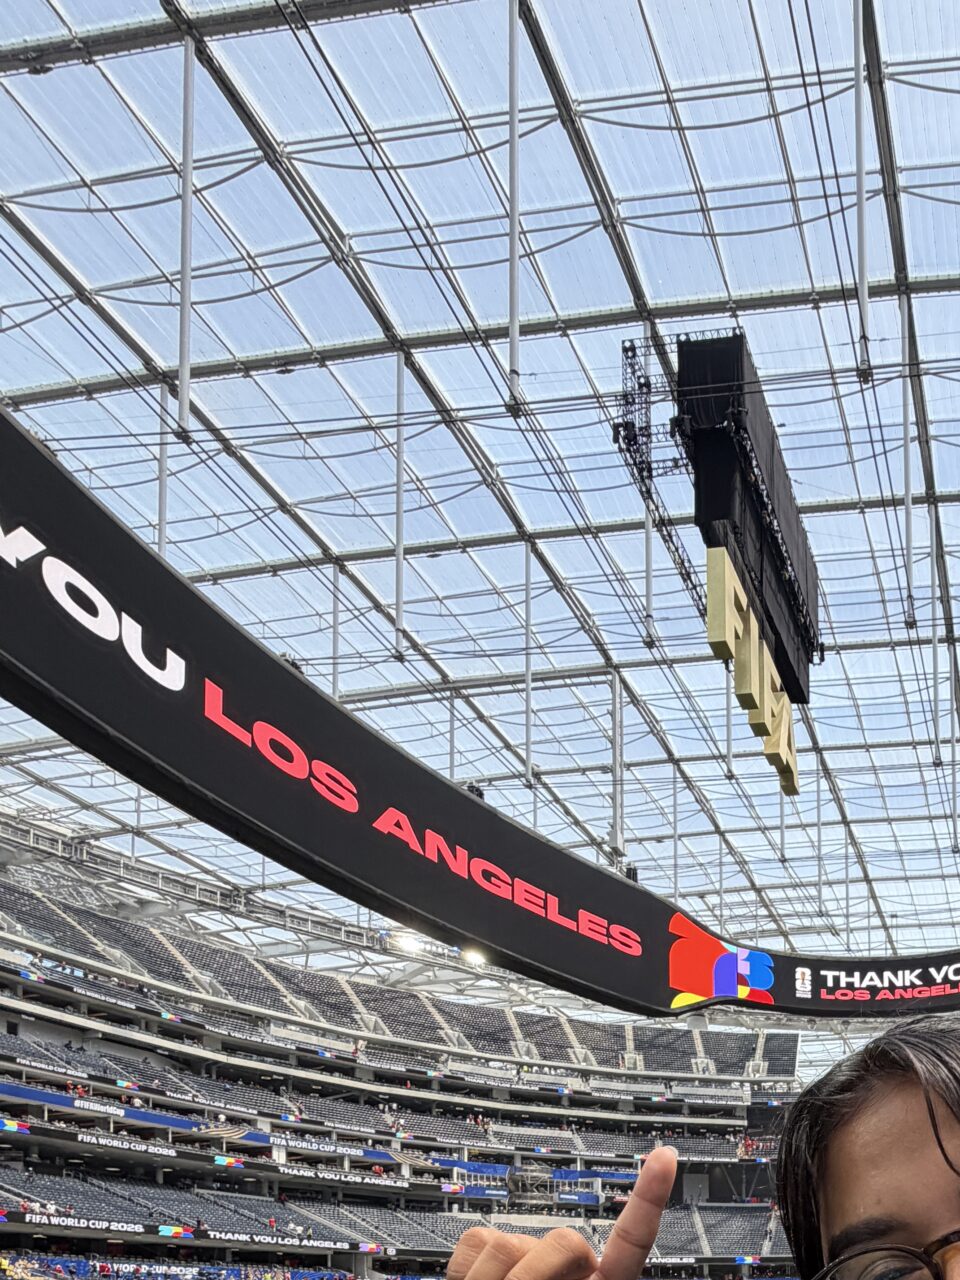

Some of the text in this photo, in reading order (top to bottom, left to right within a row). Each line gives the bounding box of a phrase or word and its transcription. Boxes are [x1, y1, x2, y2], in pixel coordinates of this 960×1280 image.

[706, 546, 799, 796] FIFA
[203, 677, 359, 814] LOS
[372, 806, 643, 958] ANGELES
[820, 969, 924, 989] THANK
[819, 988, 872, 1001] LOS
[78, 1134, 98, 1145] FIFA
[98, 1137, 130, 1150] WORLD
[130, 1140, 147, 1152] CUP
[270, 1136, 364, 1157] FIFA WORLD CUP 2026
[278, 1166, 410, 1189] THANK YOU LOS ANGELES
[25, 1214, 145, 1233] FIFA WORLD CUP 2026
[207, 1231, 350, 1250] THANK YOU LOS ANGELES
